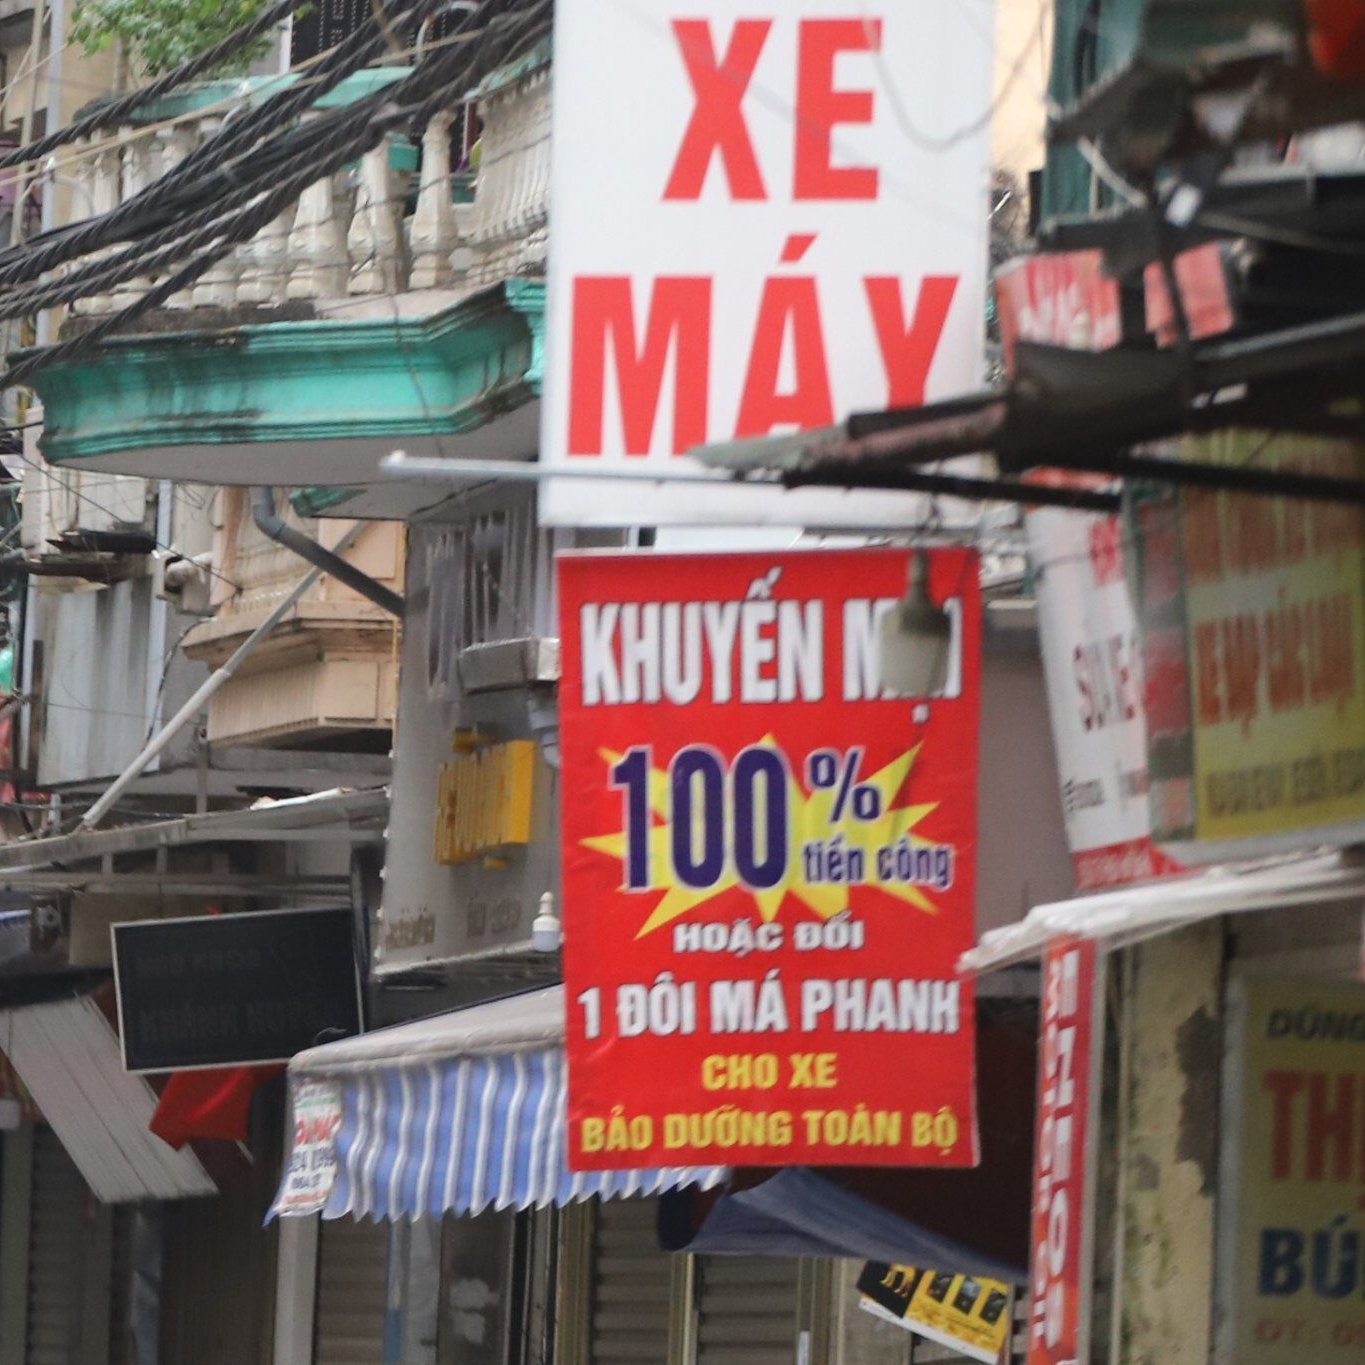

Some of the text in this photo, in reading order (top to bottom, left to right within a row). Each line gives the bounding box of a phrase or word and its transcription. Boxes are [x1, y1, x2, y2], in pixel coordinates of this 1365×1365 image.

[661, 17, 883, 202] XE
[567, 232, 960, 457] MÁY
[580, 567, 824, 706] KHUYẾN
[578, 967, 961, 1039] 1 ĐÔI MÁ PHANH
[701, 1053, 838, 1091] CHO XE
[581, 1105, 653, 1152] BẢO
[663, 1104, 792, 1150] DƯỠNG
[911, 1105, 958, 1156] BỘ
[1263, 1070, 1365, 1200] TH
[1259, 1214, 1365, 1300] BÚ
